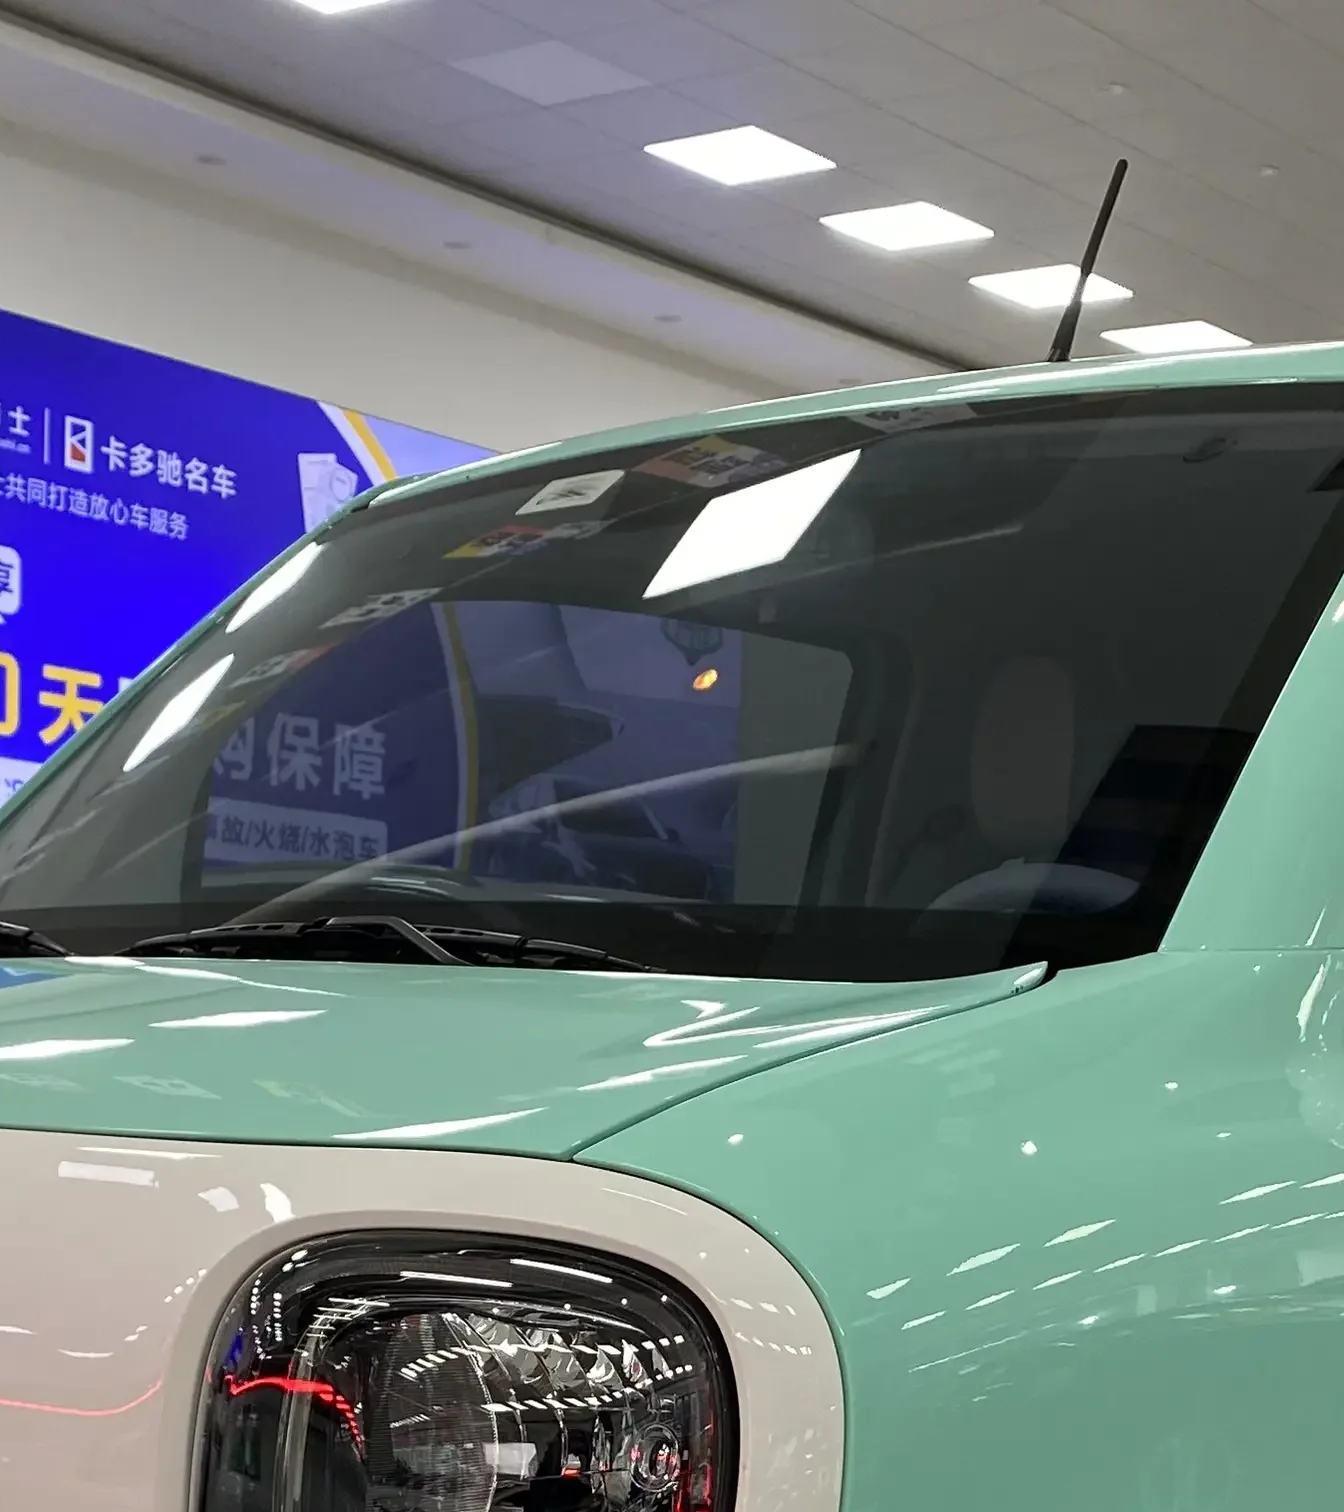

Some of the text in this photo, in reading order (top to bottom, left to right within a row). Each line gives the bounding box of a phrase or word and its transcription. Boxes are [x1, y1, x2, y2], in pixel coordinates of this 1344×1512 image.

[100, 435, 238, 500] 卡多驰名车
